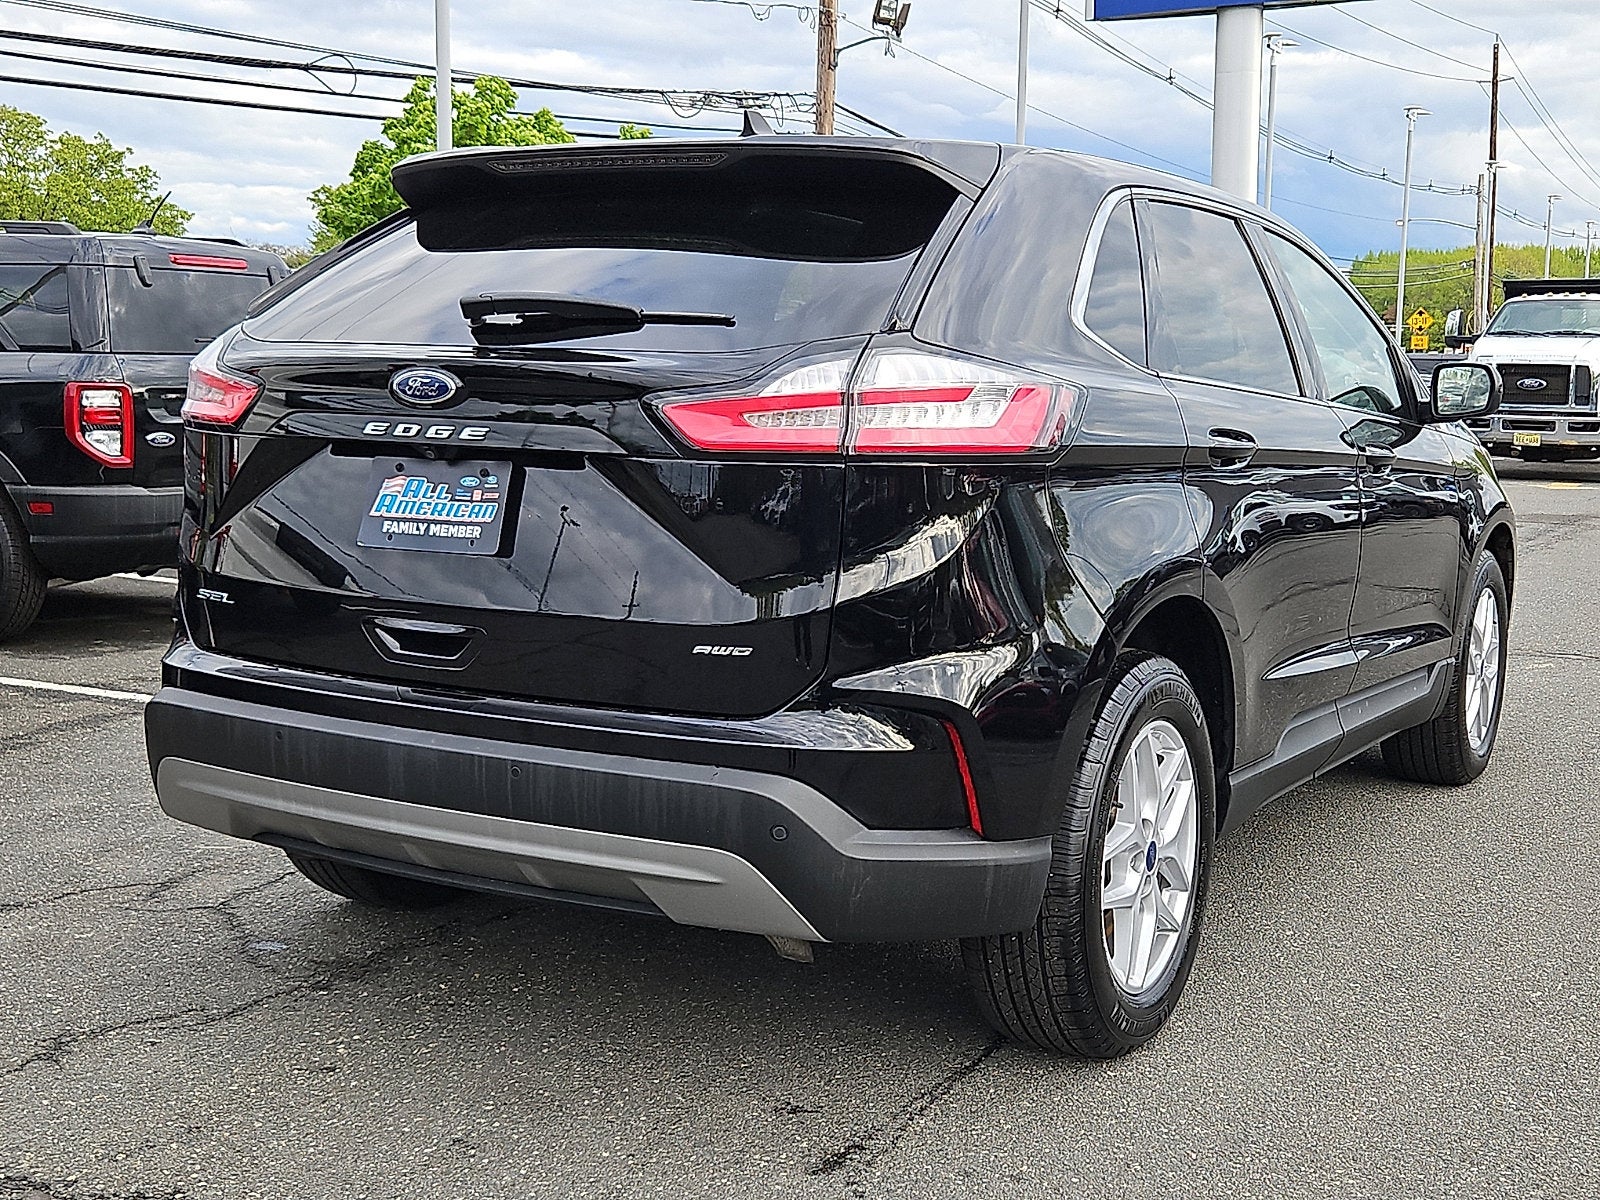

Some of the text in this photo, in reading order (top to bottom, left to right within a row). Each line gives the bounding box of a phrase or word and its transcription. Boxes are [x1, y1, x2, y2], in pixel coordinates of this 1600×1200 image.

[404, 377, 440, 396] Ford
[362, 421, 491, 440] EDGE
[382, 520, 482, 539] FAMILY MEMBER
[196, 588, 235, 604] SEL
[692, 645, 754, 656] AWD
